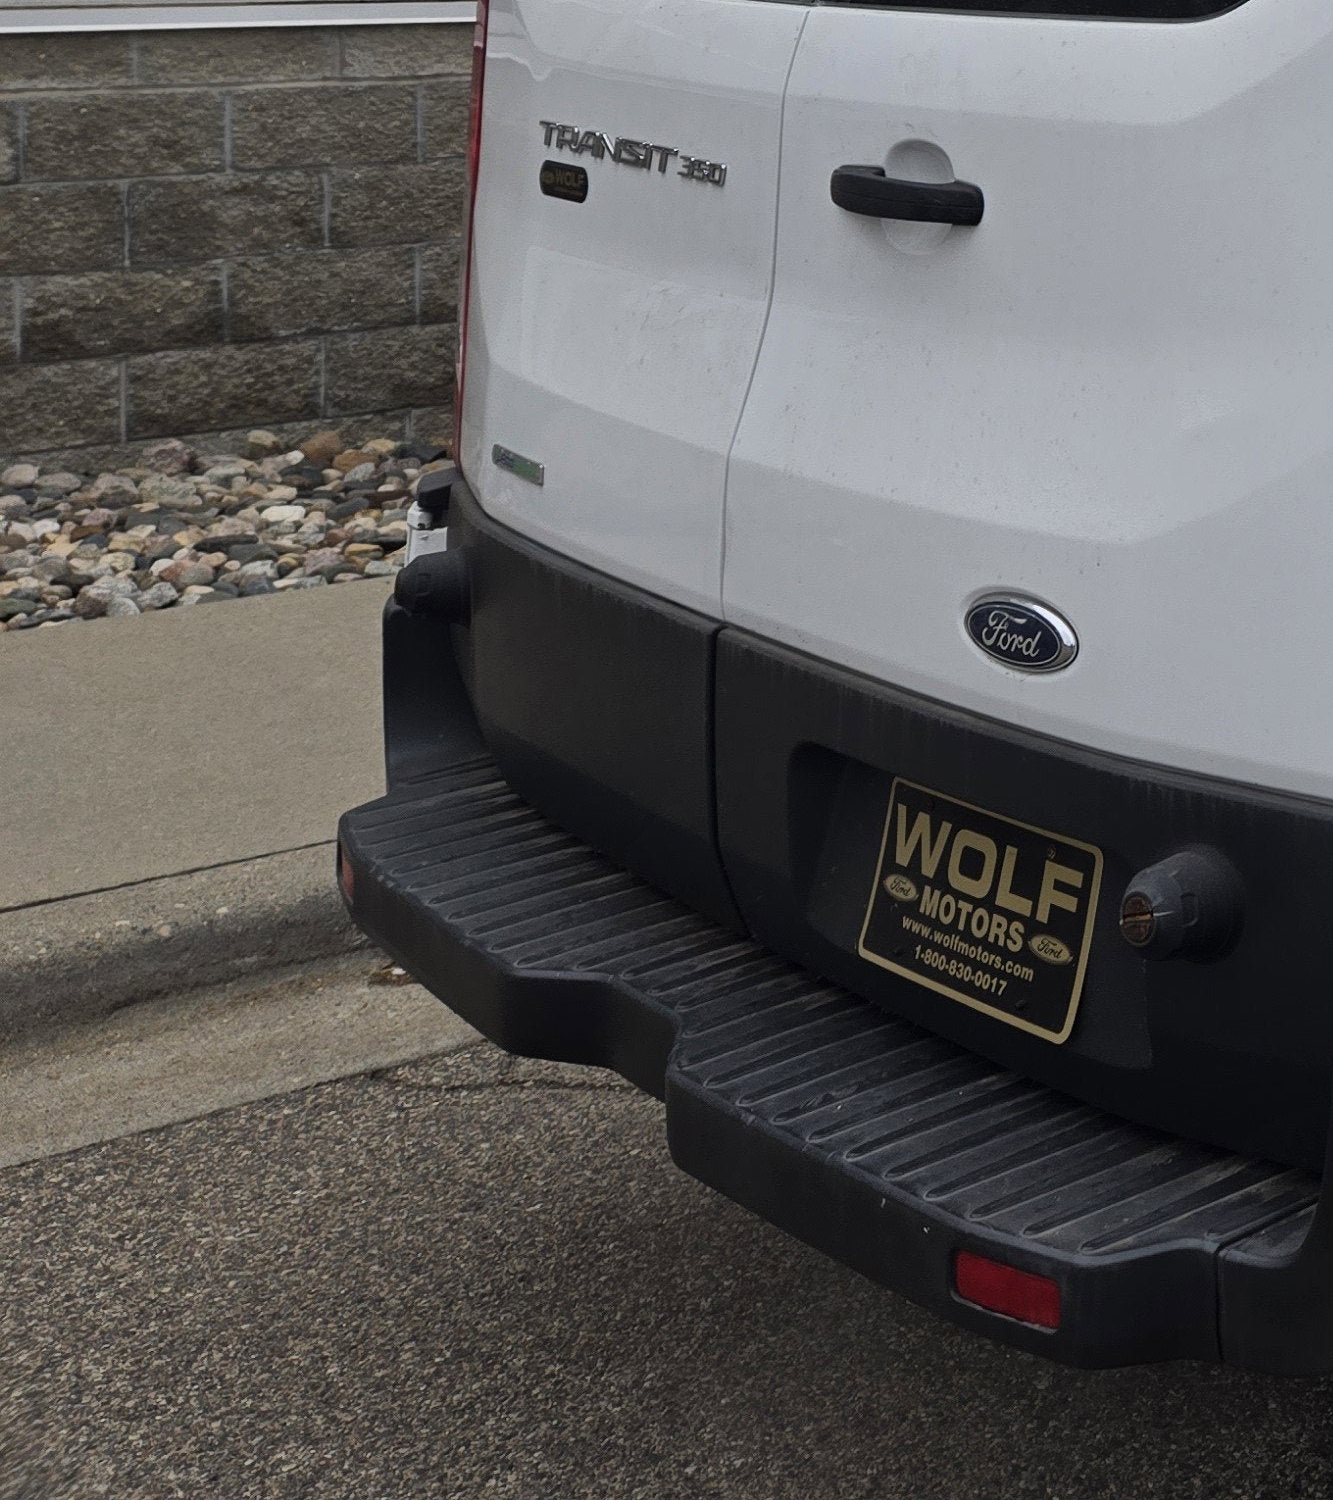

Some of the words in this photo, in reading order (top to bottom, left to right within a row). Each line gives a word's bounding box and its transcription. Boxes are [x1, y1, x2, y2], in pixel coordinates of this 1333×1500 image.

[538, 120, 680, 175] TRANSIT
[677, 154, 728, 188] 350
[981, 610, 1043, 658] Ford
[887, 875, 915, 901] Ford
[893, 801, 1086, 925] WOLF
[901, 915, 1035, 983] www.wolfmotors.com
[918, 883, 1027, 954] MOTORS
[913, 943, 1008, 997] 1-800-830-0017
[1034, 938, 1064, 962] Ford
